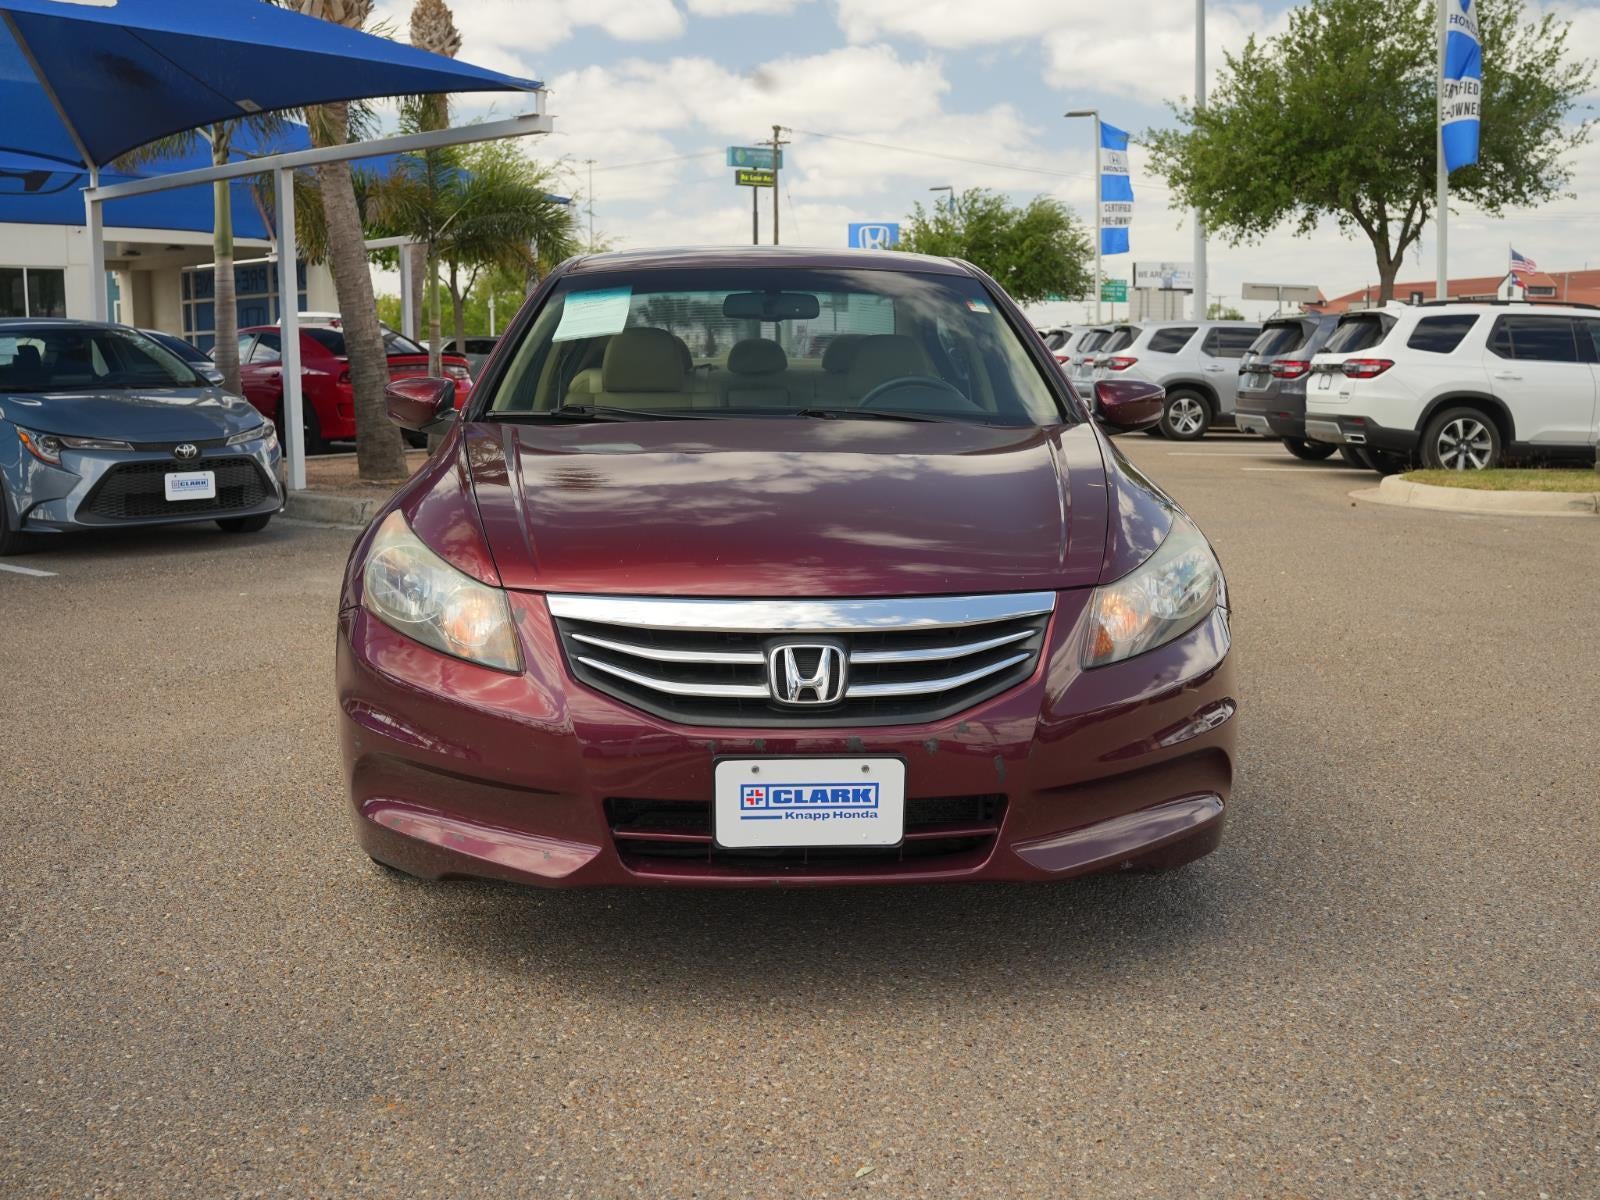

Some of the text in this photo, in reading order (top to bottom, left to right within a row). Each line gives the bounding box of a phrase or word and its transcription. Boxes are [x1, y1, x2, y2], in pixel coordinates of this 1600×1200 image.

[772, 788, 873, 804] CLARK
[784, 810, 878, 821] Knapp Honda
